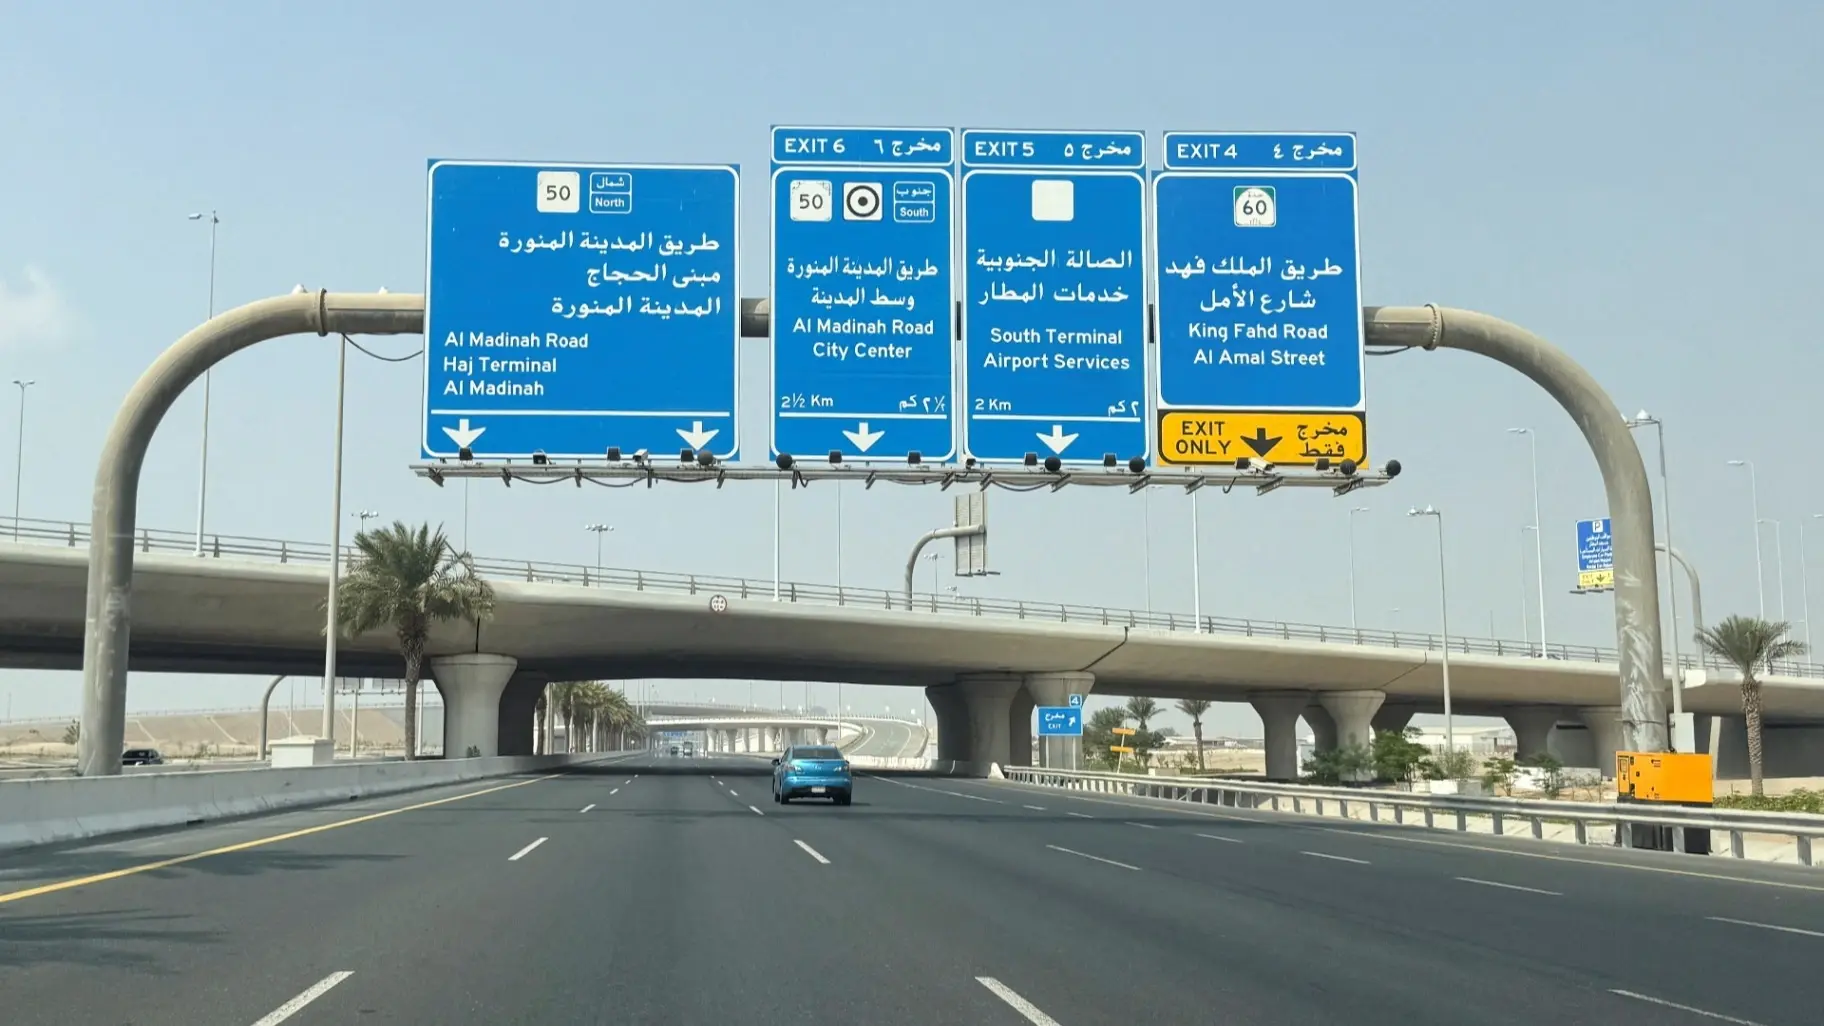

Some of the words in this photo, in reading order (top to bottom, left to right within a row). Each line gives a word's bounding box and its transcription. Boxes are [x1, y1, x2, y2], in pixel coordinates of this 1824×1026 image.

[784, 137, 828, 153] EXIT
[832, 138, 846, 154] 6
[873, 139, 884, 154] ٦
[891, 137, 942, 157] مخرج
[975, 141, 1018, 157] EXIT
[1022, 141, 1035, 157] 5
[1064, 143, 1074, 158] ٥
[1081, 142, 1132, 160] مخرج
[1177, 143, 1221, 159] EXIT
[1223, 143, 1238, 159] 4
[1273, 143, 1284, 159] ٤
[1292, 142, 1343, 161] مخرج
[596, 176, 625, 189] شمال
[546, 185, 571, 201] 50
[595, 197, 625, 208] North
[799, 193, 824, 210] 50
[900, 206, 929, 217] South
[1242, 199, 1267, 216] 60
[498, 230, 574, 254] المنورة
[579, 231, 653, 255] المدينة
[658, 232, 720, 256] طريق
[787, 255, 839, 279] المنورة
[842, 257, 893, 280] المدينة
[976, 249, 1056, 272] الجنوبية
[1066, 249, 1132, 269] الصالة
[1165, 255, 1206, 279] فهد
[1211, 256, 1272, 277] الملك
[586, 262, 667, 288] الحجاج
[896, 258, 939, 282] طريق
[1280, 257, 1343, 281] طريق
[672, 269, 721, 289] مبنى
[811, 287, 866, 309] المدينة
[870, 290, 915, 311] وسط
[978, 281, 1044, 306] المطار
[1053, 282, 1129, 303] خدمات
[1200, 283, 1254, 313] الأمل
[1260, 289, 1316, 315] شارع
[551, 295, 632, 319] المنورة
[639, 296, 721, 320] المدينة
[792, 318, 811, 333] Al
[817, 318, 886, 334] Madinah
[892, 319, 934, 335] Road
[990, 327, 1041, 343] South
[1045, 328, 1122, 345] Terminal
[1188, 322, 1228, 343] King
[1234, 323, 1278, 339] Fahd
[1283, 323, 1328, 339] Road
[444, 331, 464, 347] Al
[469, 331, 540, 348] Madinah
[545, 332, 589, 348] Road
[812, 341, 849, 361] City
[854, 342, 913, 358] Center
[1193, 348, 1213, 364] Al
[1218, 349, 1265, 365] Amal
[1271, 349, 1325, 366] Street
[443, 356, 473, 376] Haj
[478, 356, 557, 373] Terminal
[983, 352, 1049, 372] Airport
[1054, 353, 1130, 370] Services
[443, 379, 464, 396] Al
[469, 379, 544, 396] Madinah
[811, 394, 834, 407] Km
[899, 395, 917, 411] كم
[975, 398, 985, 411] 2
[989, 398, 1012, 411] Km
[1107, 400, 1126, 417] كم
[1130, 400, 1139, 417] ٢
[1182, 420, 1225, 436] EXIT
[1296, 421, 1348, 441] مخرج
[1175, 439, 1232, 455] ONLY
[1299, 441, 1345, 458] فقط
